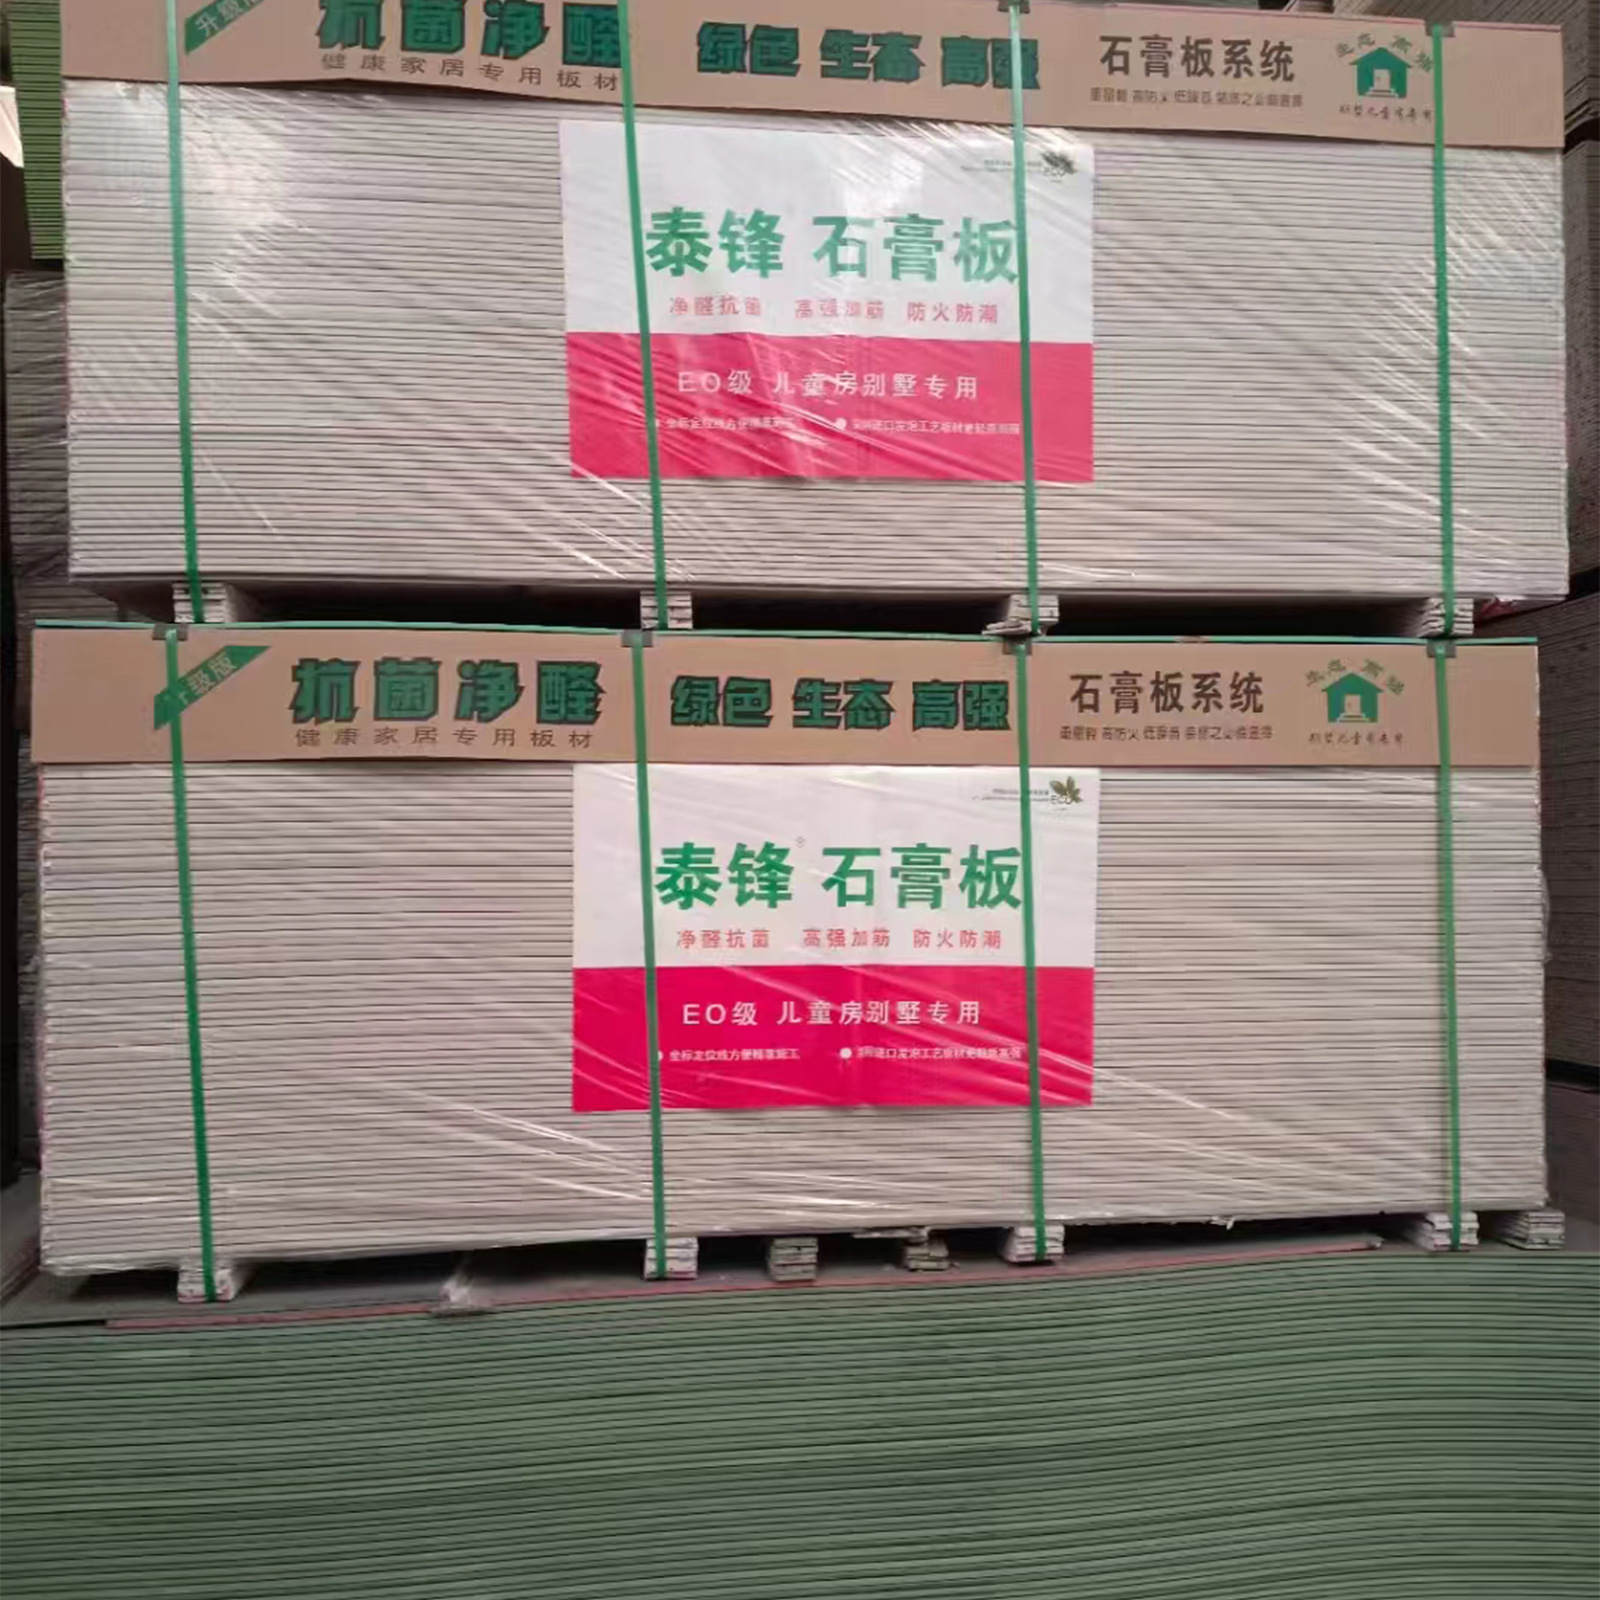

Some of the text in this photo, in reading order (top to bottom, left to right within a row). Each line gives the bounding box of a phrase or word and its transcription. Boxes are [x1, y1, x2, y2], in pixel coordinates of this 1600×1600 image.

[321, 52, 619, 91] 健康家居专用板材
[696, 21, 802, 77] 绿色
[819, 28, 927, 83] 生态
[1099, 34, 1295, 82] 石膏板系统
[646, 206, 1020, 283] 泰锋 石膏板
[906, 302, 998, 324] 防火防潮
[773, 373, 979, 400] 儿童房别墅专用
[290, 658, 606, 724] 抗菌净醛
[671, 675, 1011, 731] 绿色 生态 高强
[1069, 670, 1265, 714] 石膏板系统
[295, 726, 594, 749] 健康家居专用板材
[655, 842, 1023, 910] 泰锋 石膏板
[676, 928, 1002, 949] 净醛抗菌 高强加筋 防火防潮
[776, 1000, 981, 1026] 儿童房别墅专用
